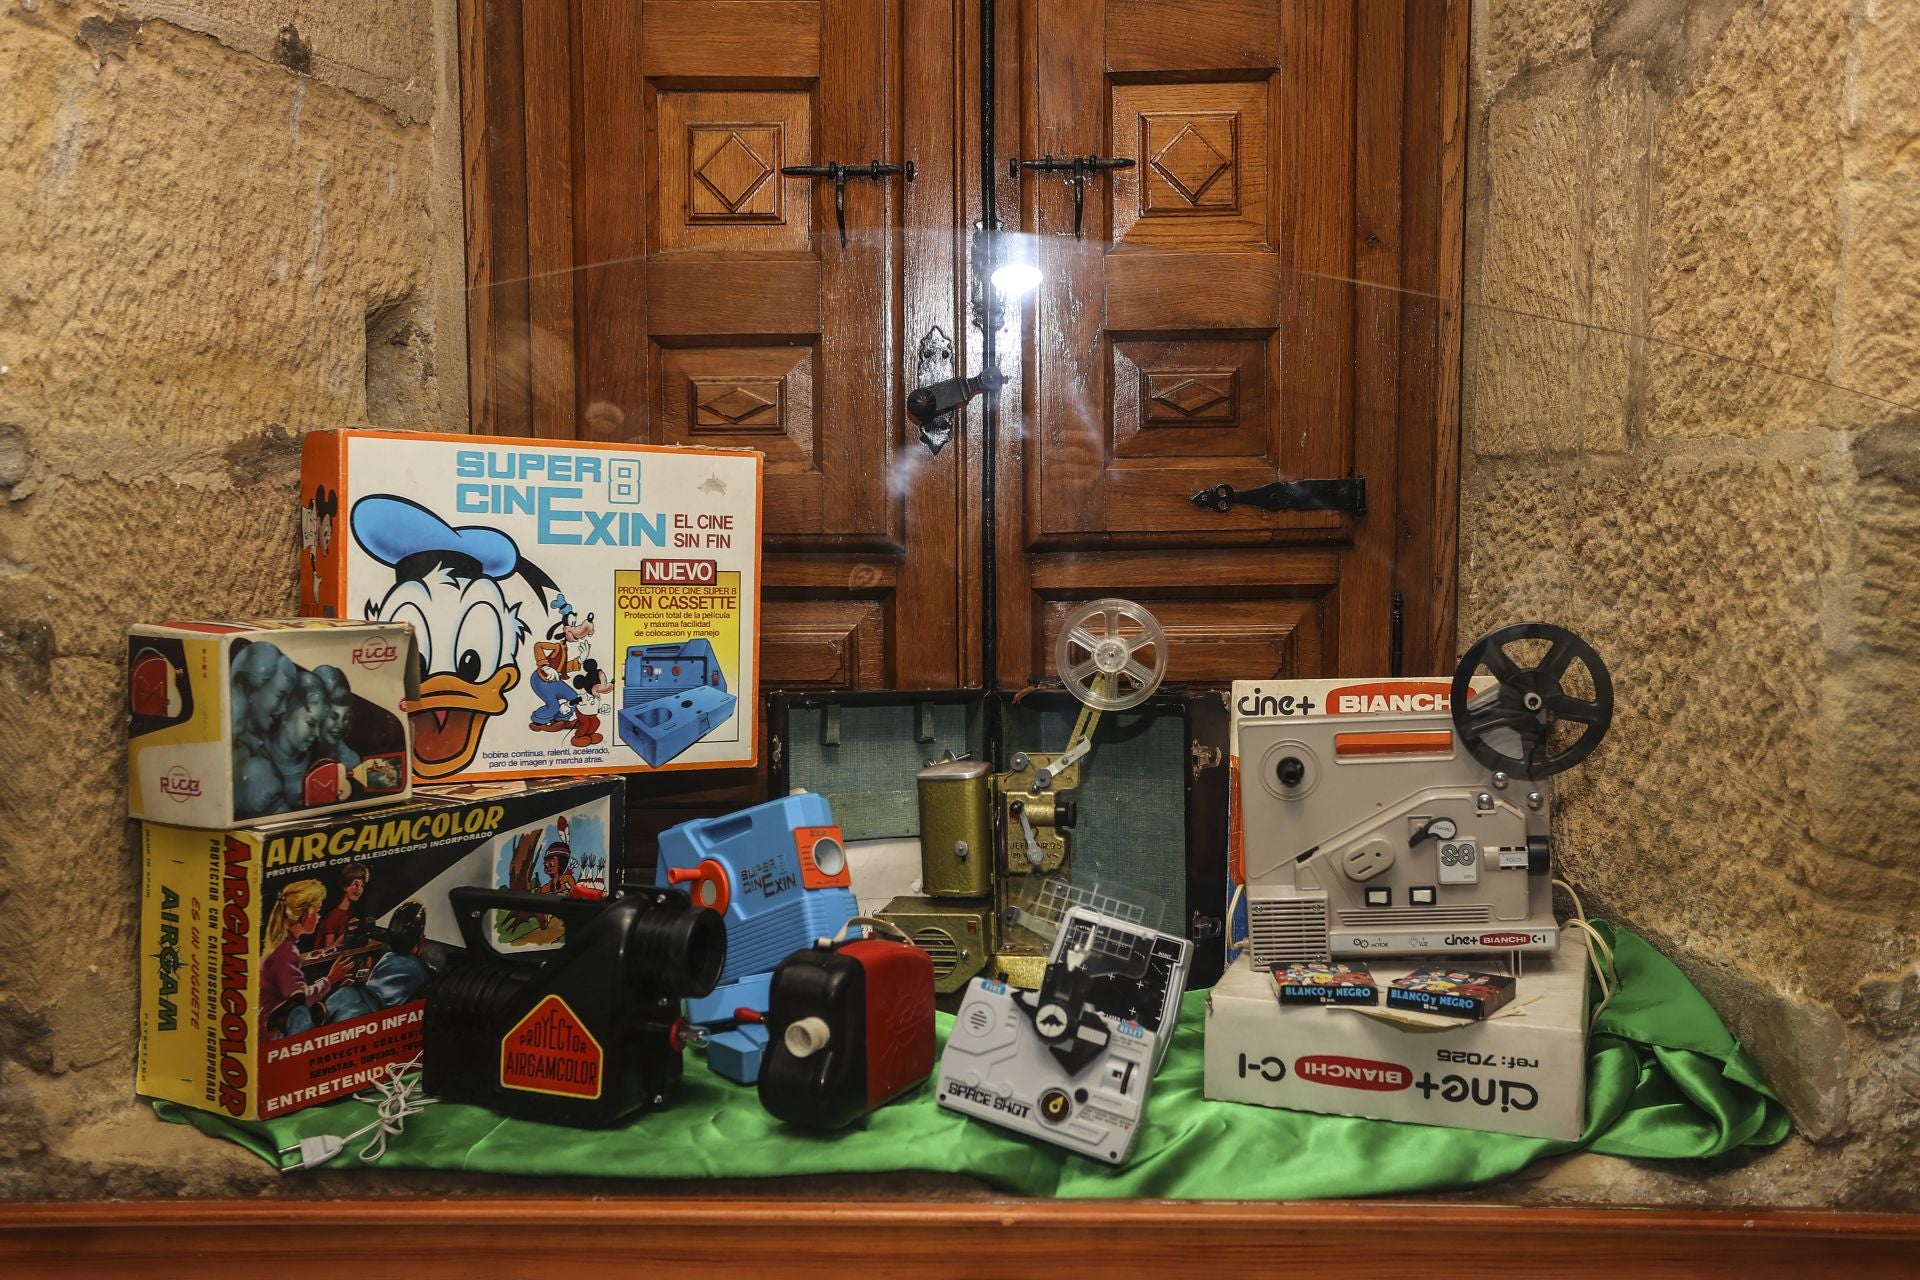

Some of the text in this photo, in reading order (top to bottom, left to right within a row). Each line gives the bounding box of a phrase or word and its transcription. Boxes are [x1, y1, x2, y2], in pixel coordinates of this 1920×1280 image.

[456, 450, 641, 505] SUPER 8
[456, 483, 667, 548] CINEXIN
[673, 514, 734, 530] EL CINE
[673, 532, 731, 549] SIN FIN
[645, 561, 713, 581] NUEVO
[617, 586, 737, 595] PROYECTOR DE CINE SUPER 8
[617, 595, 737, 610] CON CASSETTE
[624, 611, 664, 619] Protección
[665, 611, 682, 619] total
[702, 611, 731, 621] película
[650, 620, 679, 628] máxima
[680, 620, 711, 628] facilidad
[645, 629, 686, 637] colocación
[686, 631, 693, 639] y
[693, 630, 720, 639] manejo
[1237, 687, 1452, 716] cine+ BIANCH
[482, 751, 509, 759] bobina
[489, 760, 506, 769] paro
[508, 759, 518, 767] de
[519, 758, 548, 768] imagen
[549, 759, 554, 767] y
[555, 757, 583, 765] marcha
[265, 805, 505, 868] AIRGAMCOLOR
[265, 831, 494, 879] PROYECTOR CON CALEIDOSCOPIO INCORPORADO
[742, 871, 797, 899] CINEXIN
[1444, 933, 1479, 946] cine+
[1483, 936, 1528, 945] BIANCHI
[158, 884, 180, 1031] AIRGAM
[190, 896, 201, 1031] ES UN JUGUETE
[205, 838, 220, 1102] PROYECTOR CON CALEIDOSCOPIO INCORPORADO
[219, 834, 252, 1117] AIRGAMCOLOR
[1285, 986, 1327, 997] BLANCO
[1336, 987, 1372, 998] NEGRO
[1390, 988, 1430, 1002] BLANCO
[1439, 995, 1475, 1010] NEGRO
[267, 1022, 379, 1064] PASATIEMPO
[519, 1008, 587, 1053] PROYECTOR
[141, 1012, 149, 1082] PATENTADO
[309, 1043, 368, 1067] PROYECTA
[1436, 1049, 1540, 1069] ref: 7025
[505, 1051, 598, 1086] AIRGAMCOLOR
[1304, 1061, 1403, 1085] BIANCHI
[266, 1062, 396, 1112] ENTRETENIDO
[948, 1081, 1031, 1119] SPACE SHOT
[1414, 1071, 1539, 1113] cine+
